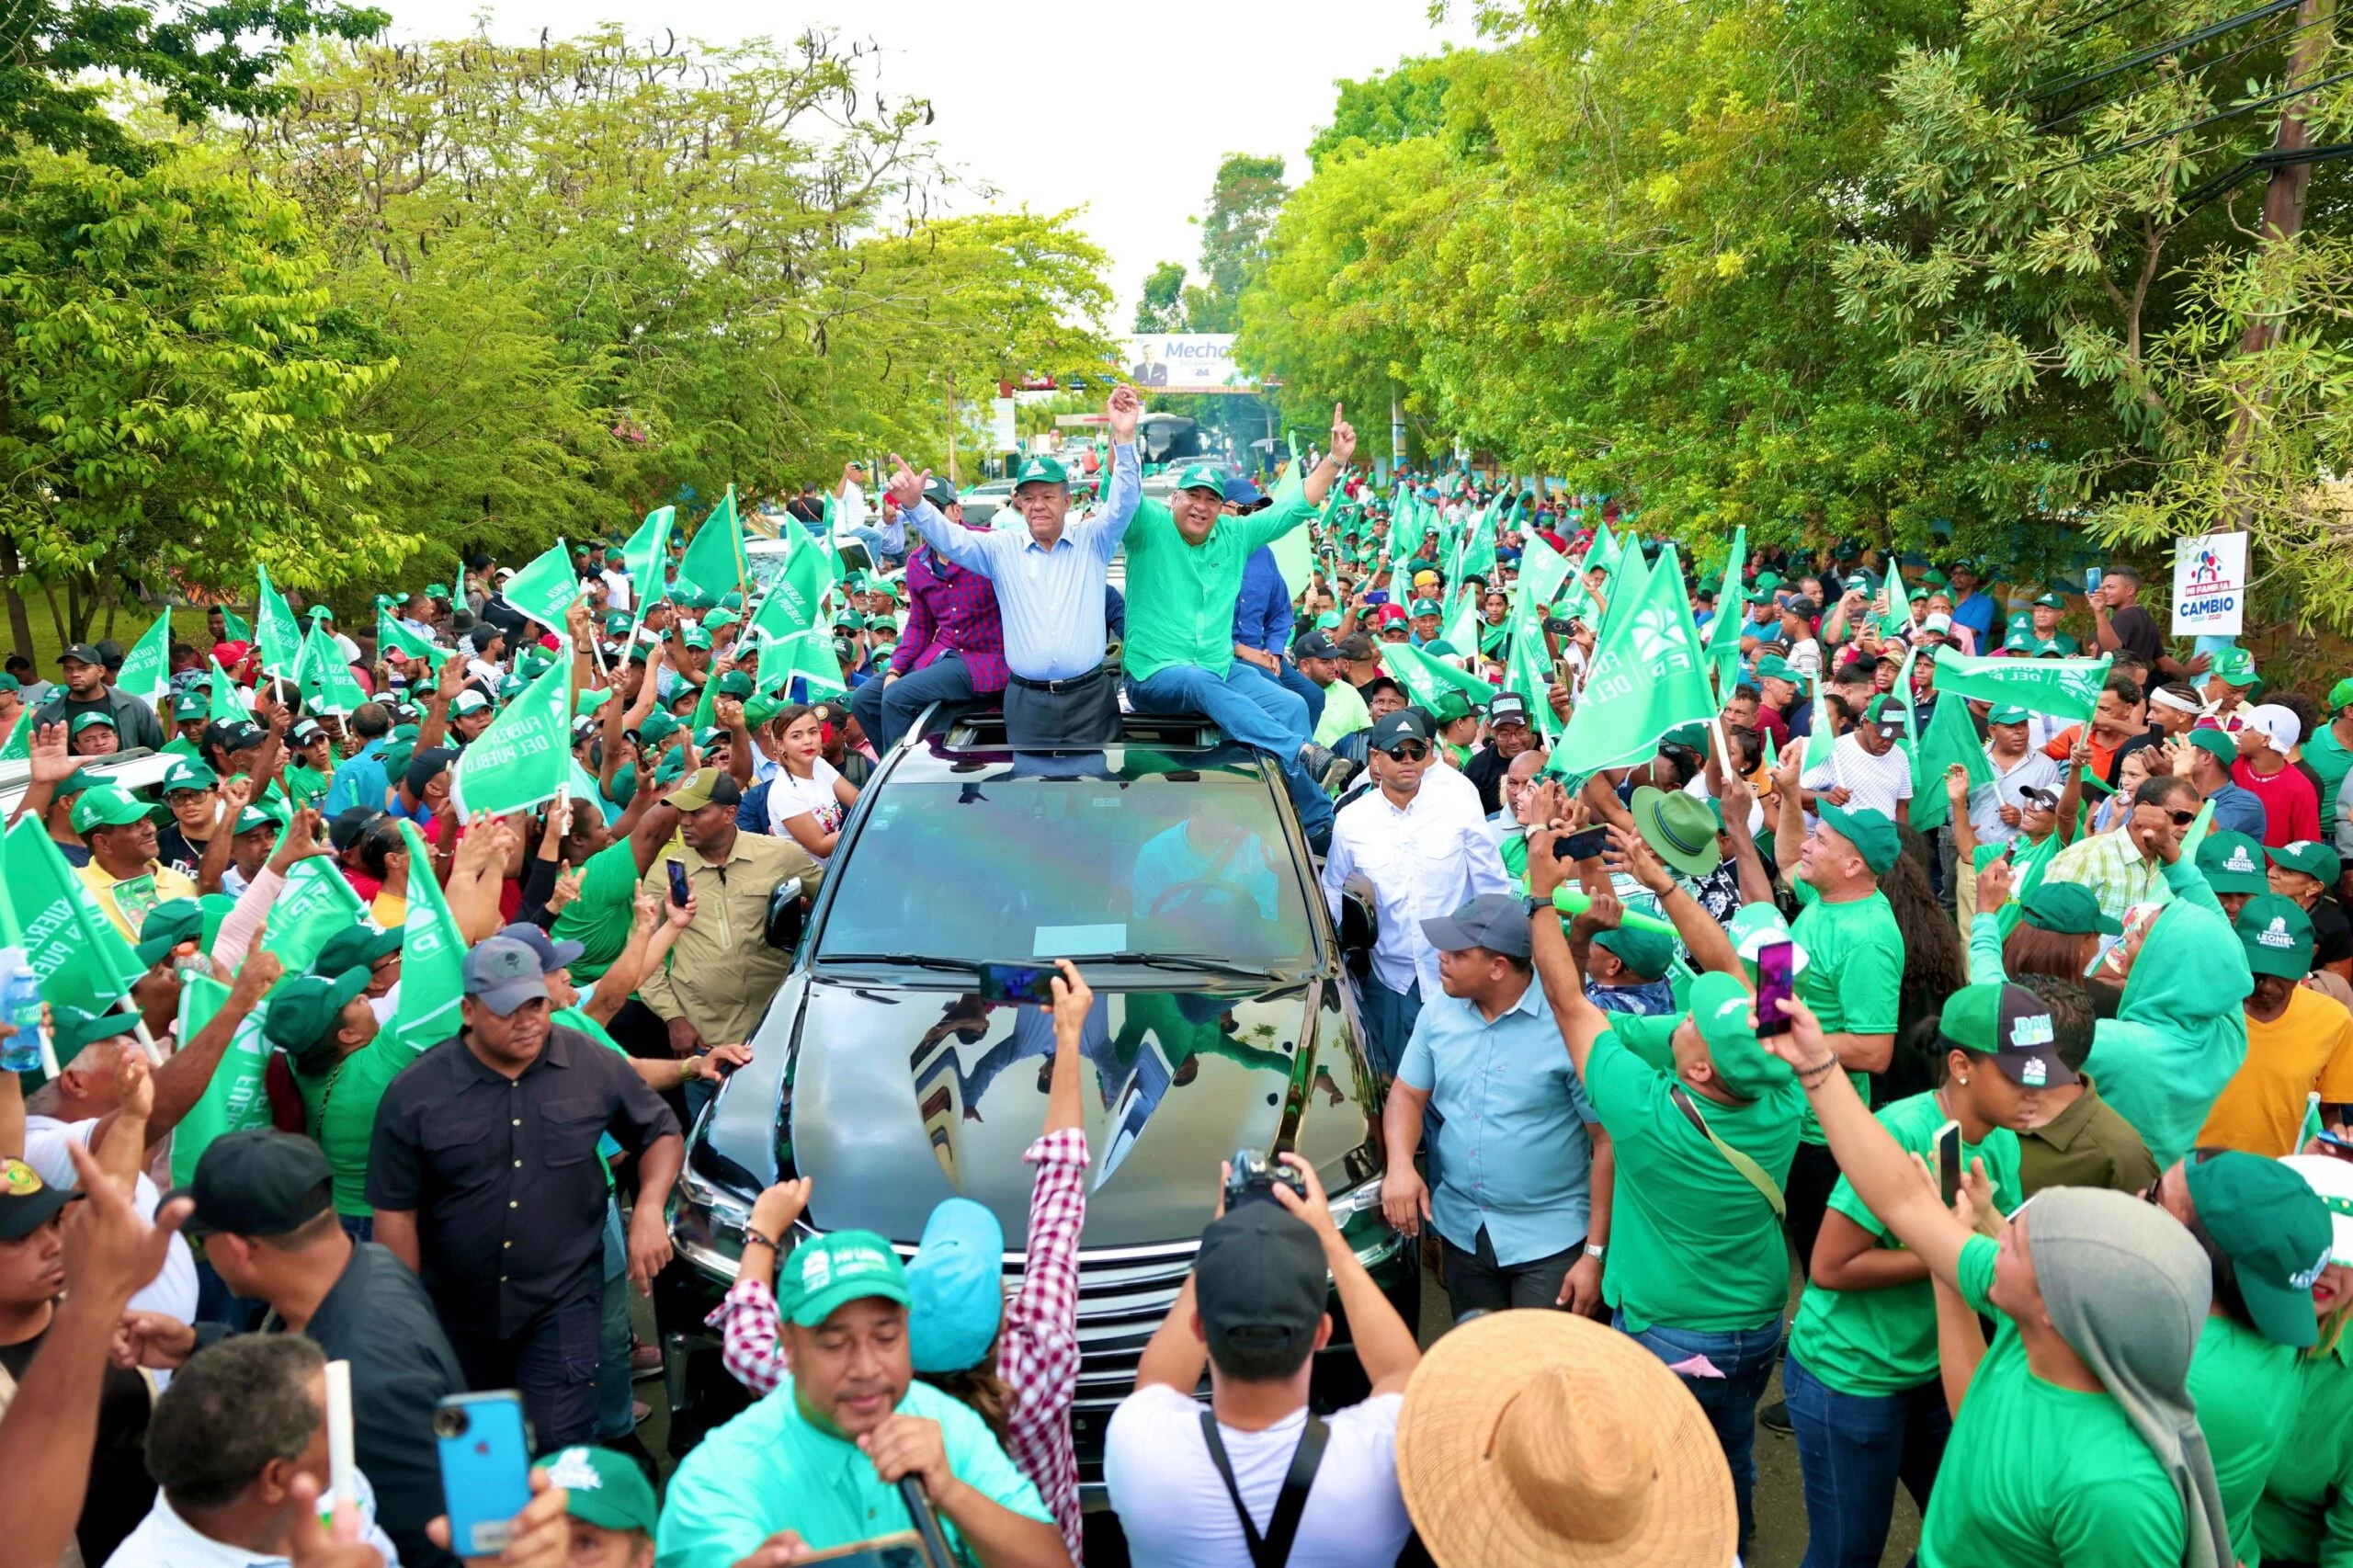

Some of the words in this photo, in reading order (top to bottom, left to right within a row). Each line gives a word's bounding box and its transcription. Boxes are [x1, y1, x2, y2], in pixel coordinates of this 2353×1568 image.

[2186, 585, 2196, 596] MI
[2196, 581, 2230, 595] FAMILIA
[779, 597, 805, 626] PUEBLO
[2180, 597, 2234, 618] CAMBIO
[2222, 860, 2256, 869] LEONEL
[2256, 933, 2296, 946] LEONEL
